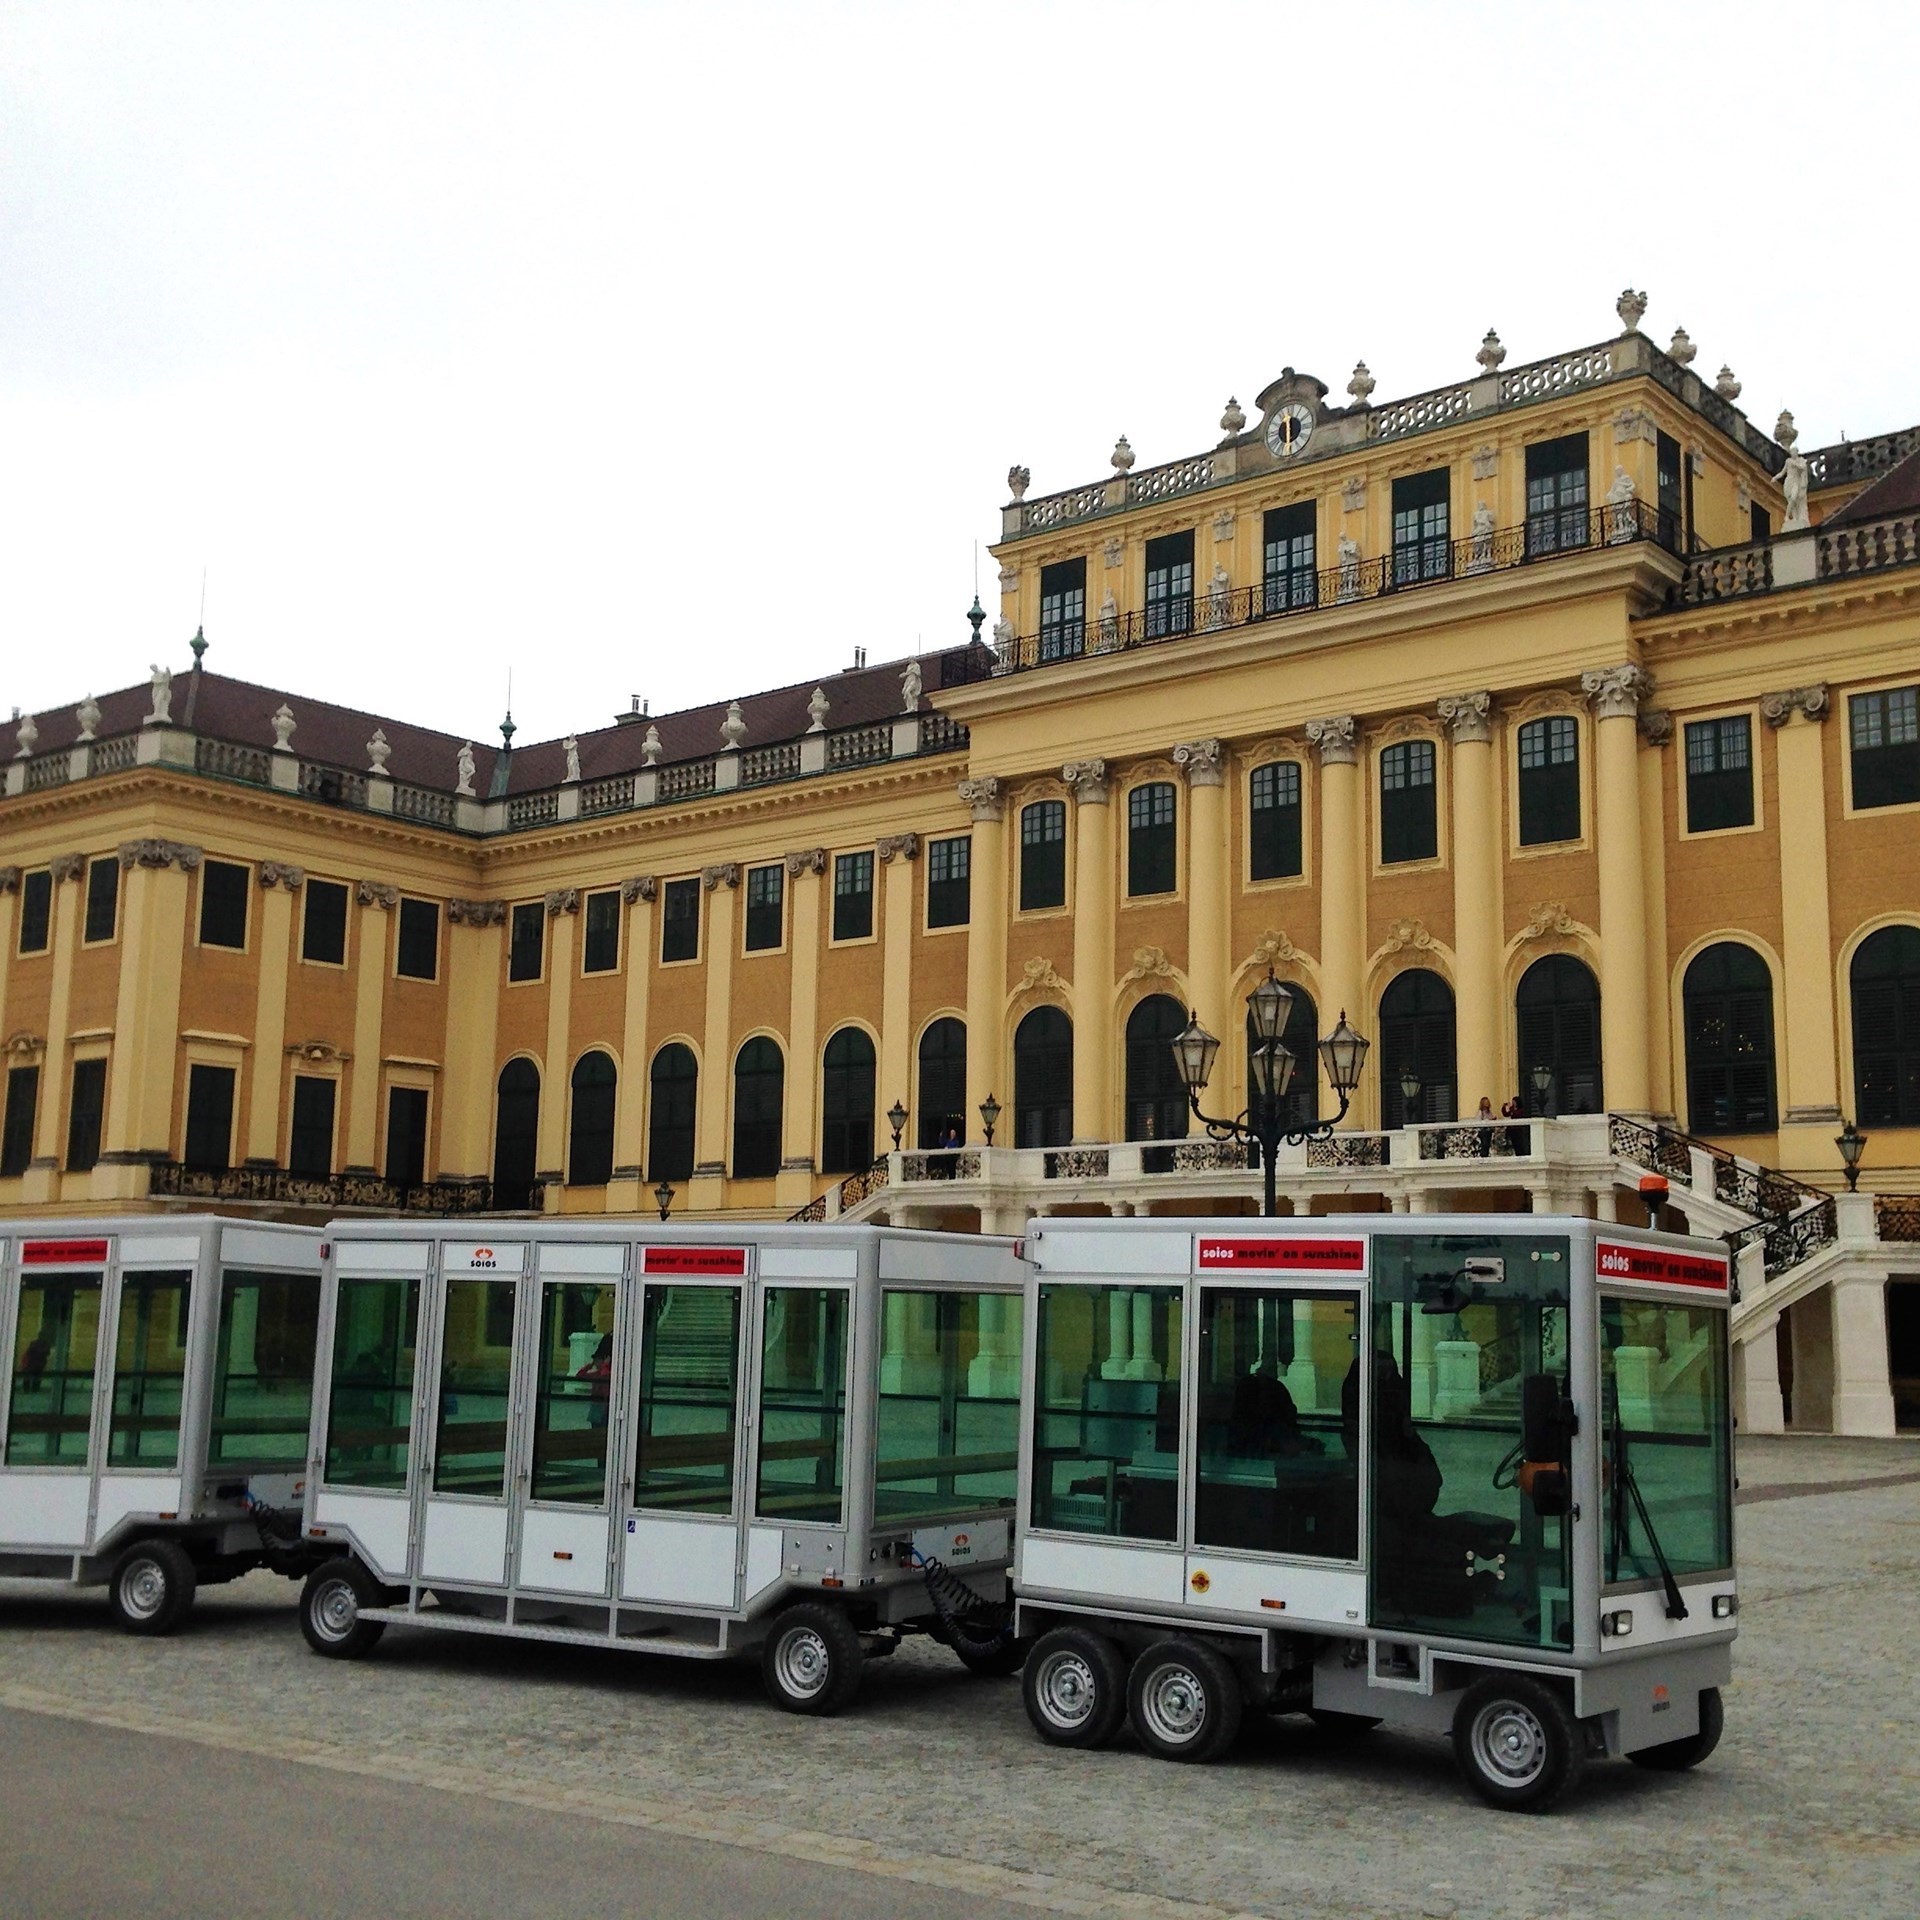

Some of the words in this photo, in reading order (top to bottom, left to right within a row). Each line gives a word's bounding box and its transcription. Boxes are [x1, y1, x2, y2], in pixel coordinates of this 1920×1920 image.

[1202, 1246, 1234, 1259] soios
[1282, 1250, 1299, 1259] on
[1302, 1248, 1360, 1260] sunshine
[1601, 1249, 1630, 1272] soios
